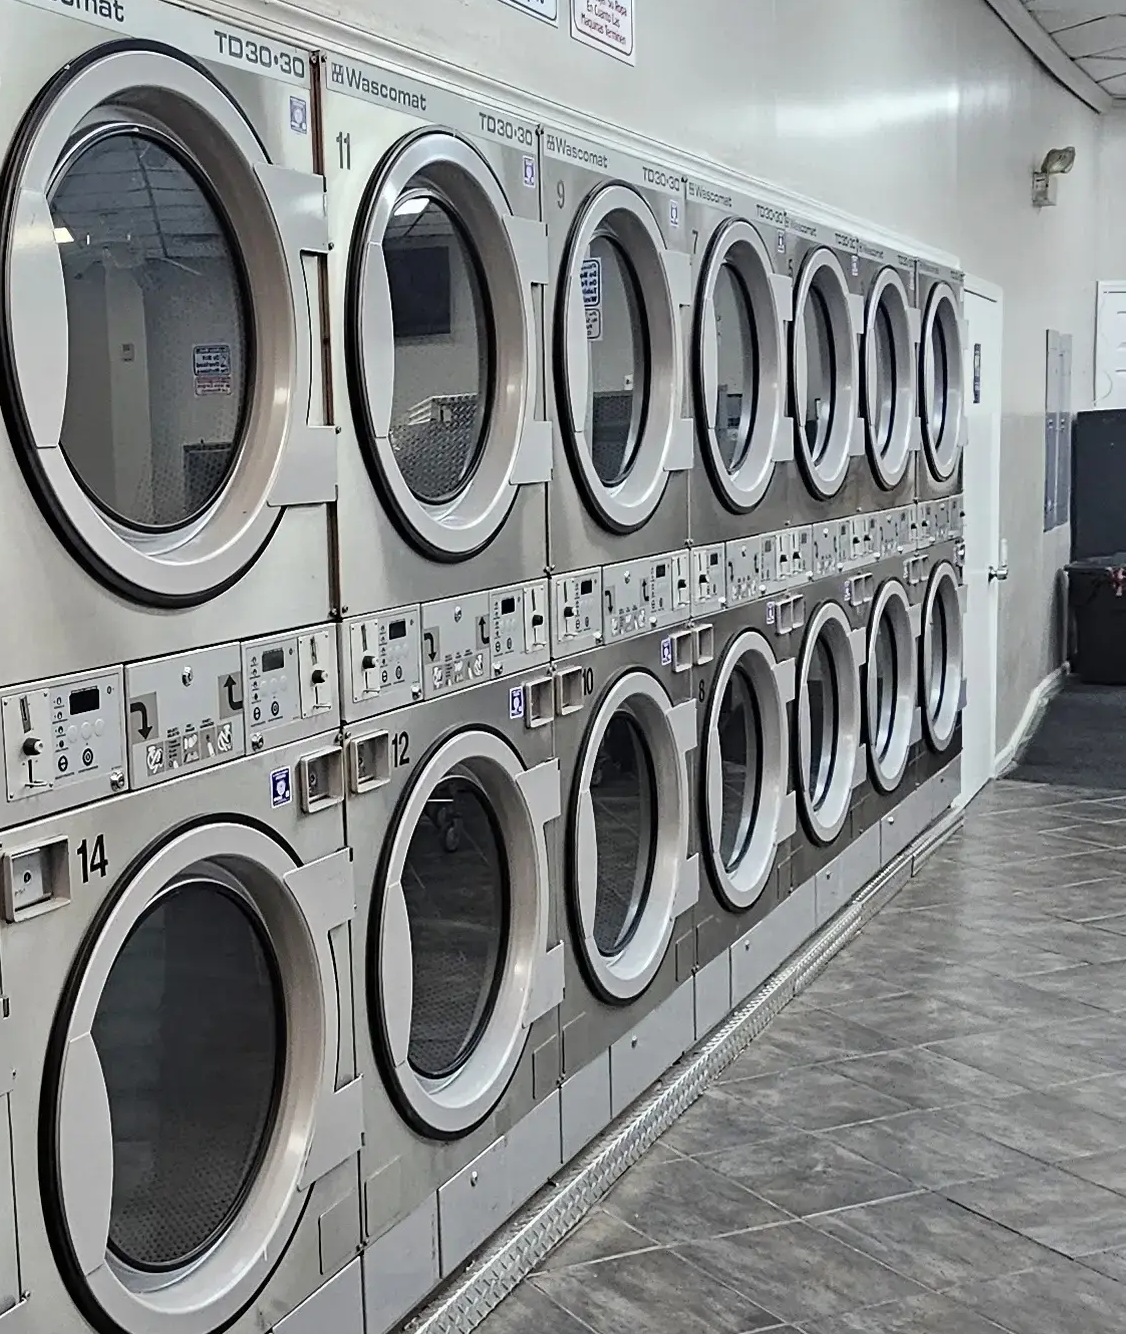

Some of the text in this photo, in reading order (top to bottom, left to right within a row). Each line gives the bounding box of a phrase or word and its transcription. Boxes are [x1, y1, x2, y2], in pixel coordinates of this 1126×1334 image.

[346, 67, 427, 111] Wascomat
[336, 131, 351, 170] 11
[555, 138, 608, 169] Wascomat
[557, 180, 566, 209] 9
[692, 229, 699, 255] 7
[583, 667, 594, 695] 10
[699, 679, 705, 703] 8
[392, 731, 410, 768] 12
[77, 834, 108, 883] 14
